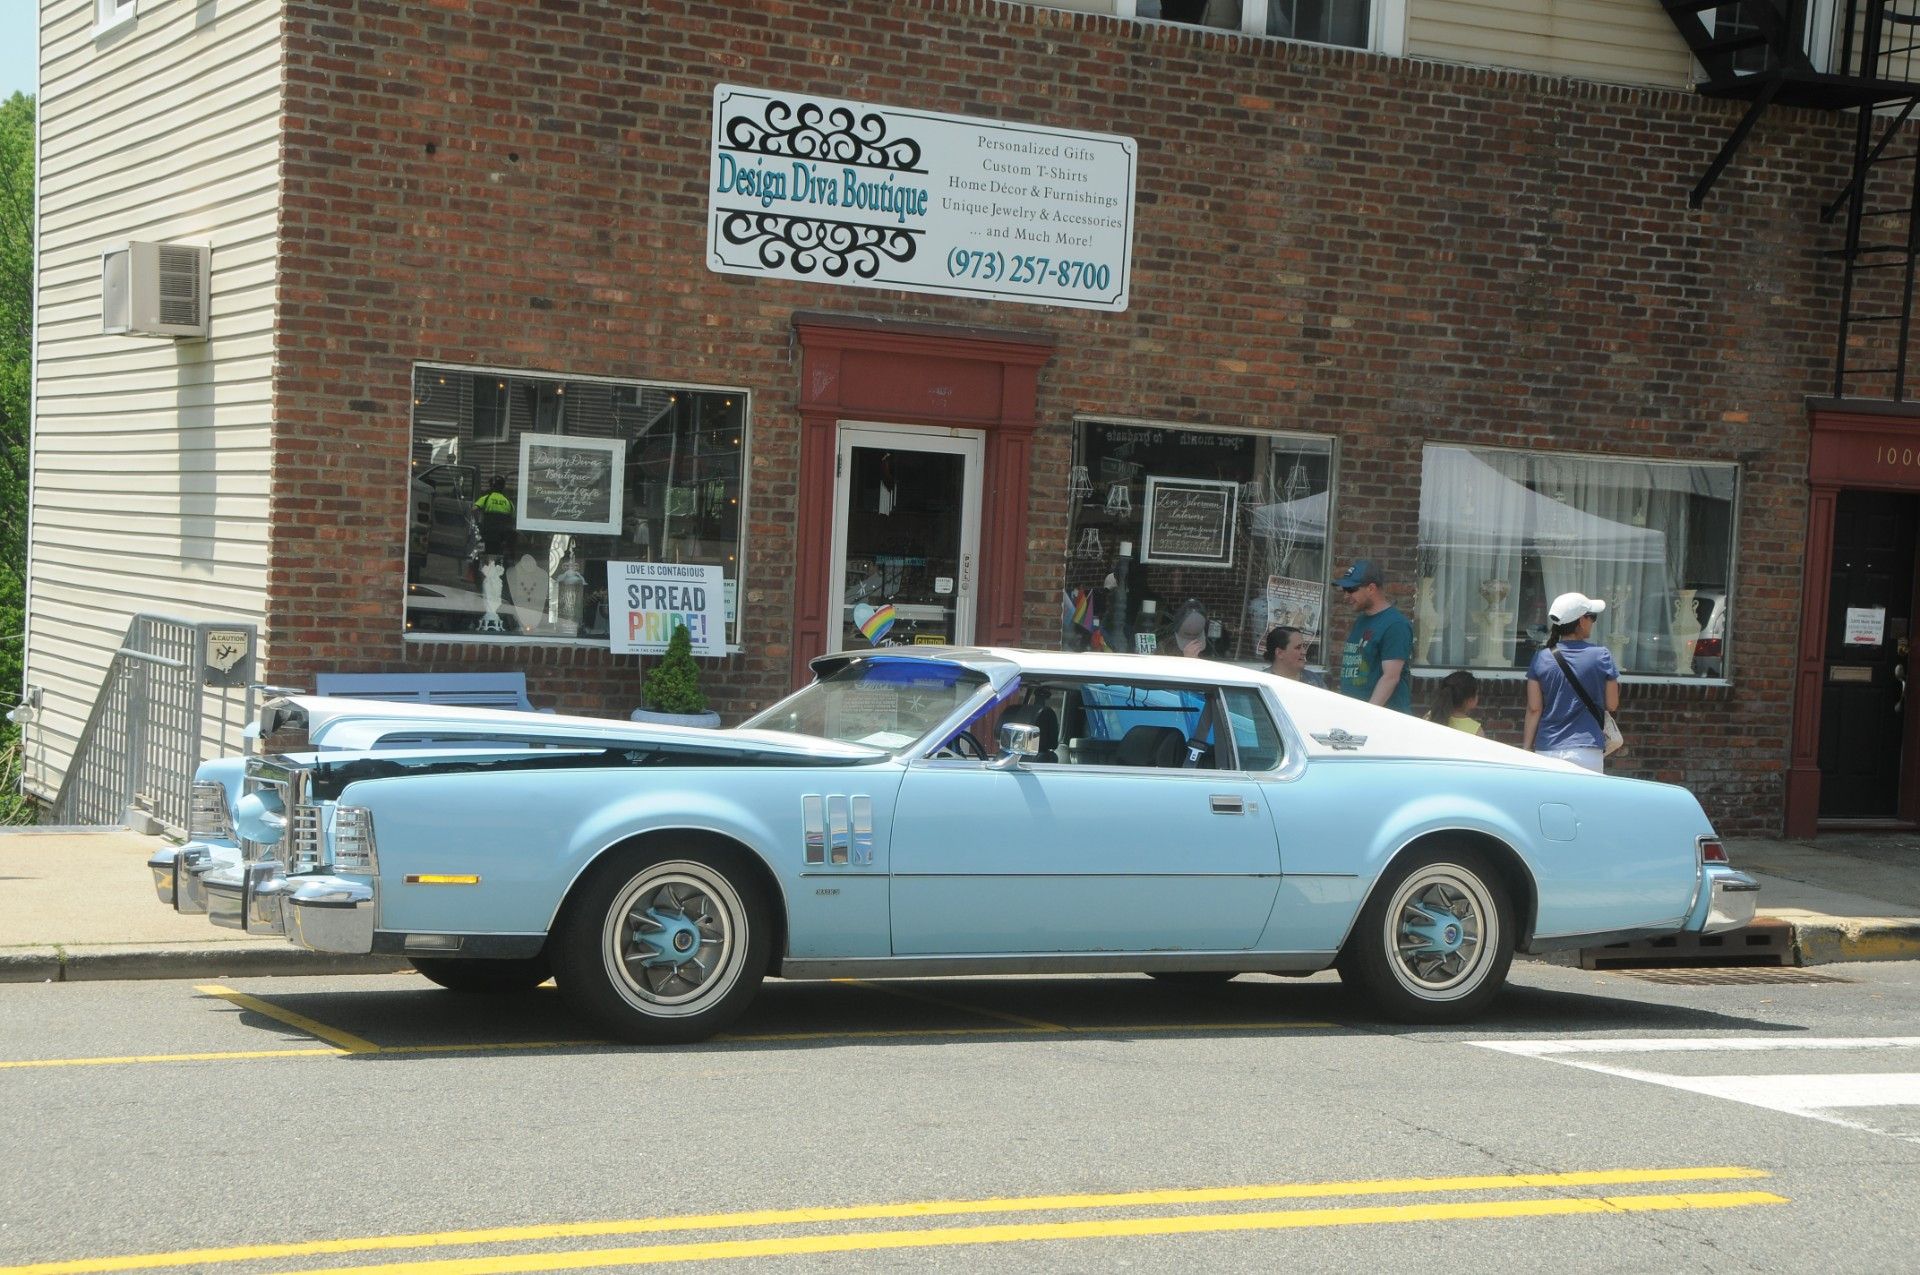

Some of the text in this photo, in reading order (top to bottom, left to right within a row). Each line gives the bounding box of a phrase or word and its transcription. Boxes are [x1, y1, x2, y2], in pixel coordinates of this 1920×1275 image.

[977, 135, 1096, 162] Personalized Gifts
[982, 158, 1089, 183] Custom T-Shirts
[717, 152, 929, 223] Design Diva Boutique
[948, 175, 1119, 207] Home Décor & Furnishings
[941, 197, 1123, 229] Unique Jewelry & Accessories
[986, 225, 1010, 239] and
[1014, 226, 1051, 243] Much
[1055, 230, 1094, 247] More!
[946, 246, 1112, 291] (973) 257-8700
[626, 564, 705, 577] LOVE IS CONTAGIOUS
[627, 584, 706, 612] SPREAD
